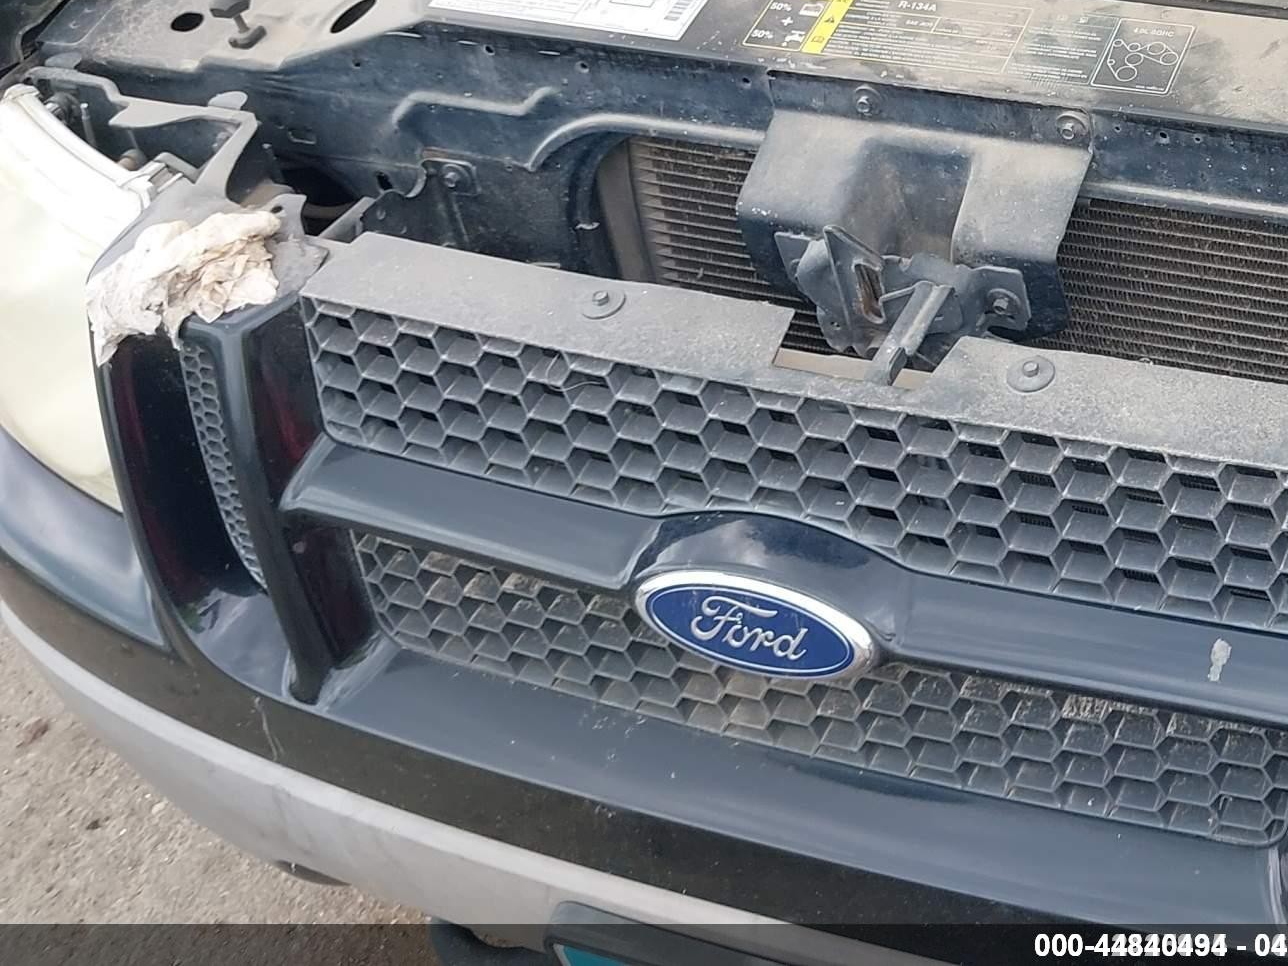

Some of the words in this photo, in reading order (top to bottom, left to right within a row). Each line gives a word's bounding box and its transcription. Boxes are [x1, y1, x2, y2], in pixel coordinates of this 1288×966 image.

[770, 1, 792, 12] 50%
[898, 0, 937, 12] R-134A
[751, 29, 774, 40] 50%
[690, 595, 809, 661] Ford
